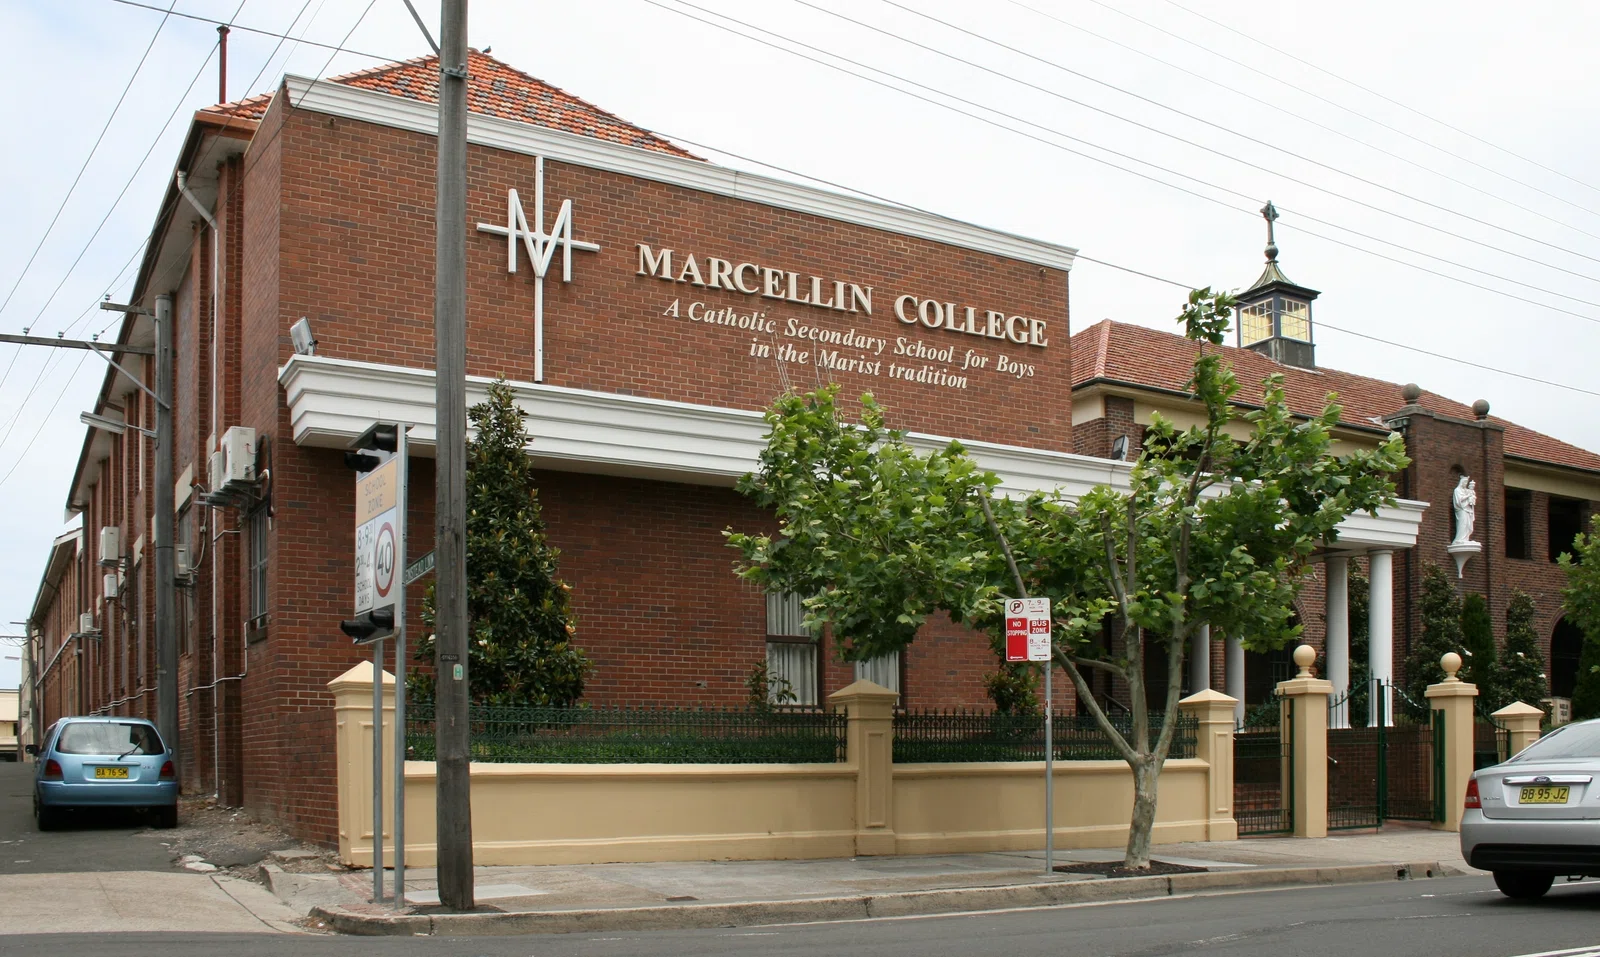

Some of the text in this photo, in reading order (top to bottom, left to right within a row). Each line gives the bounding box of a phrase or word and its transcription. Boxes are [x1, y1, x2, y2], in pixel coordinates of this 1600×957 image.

[635, 243, 1048, 348] MARCELLIN COLLEGE
[663, 298, 1035, 379] A Catholic Secondary School for Boys
[749, 338, 968, 390] in the Marist tradition
[364, 474, 387, 497] SCHOOL
[367, 493, 383, 515] ZONE
[377, 541, 392, 576] 40
